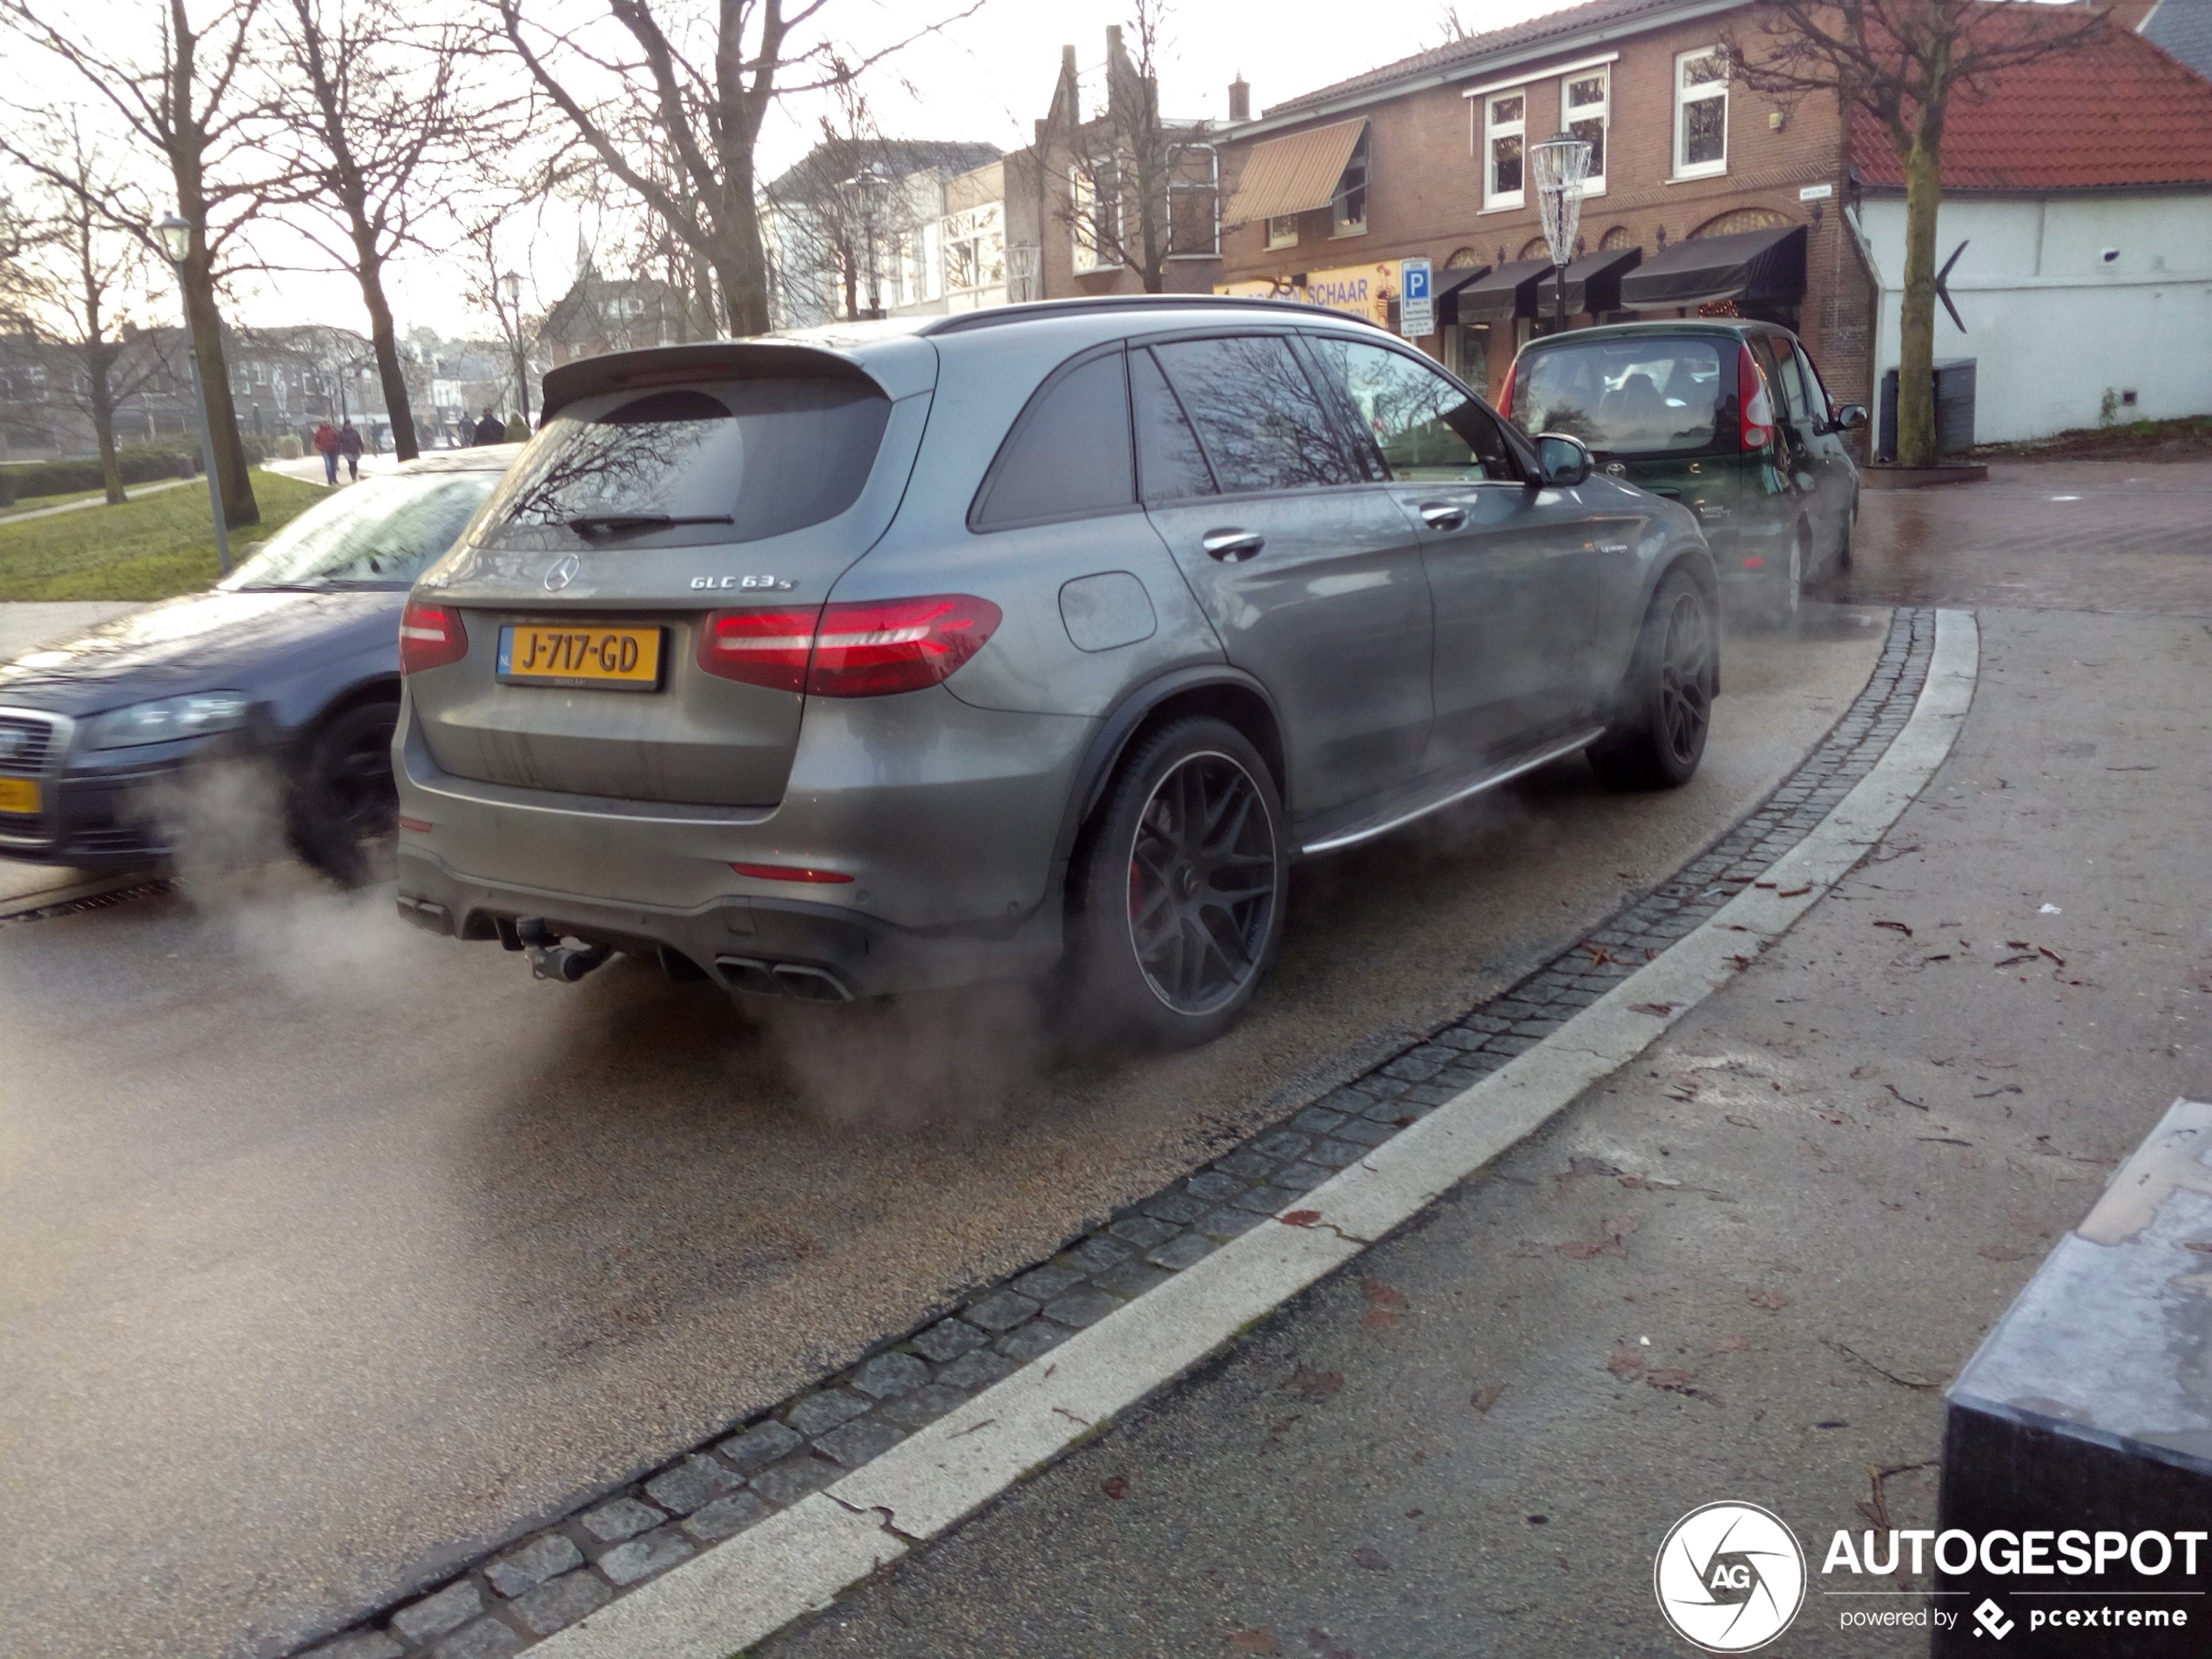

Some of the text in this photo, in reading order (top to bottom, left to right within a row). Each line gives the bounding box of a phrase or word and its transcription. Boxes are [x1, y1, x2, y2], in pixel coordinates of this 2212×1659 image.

[1307, 279, 1368, 306] SCHAAR
[1411, 273, 1424, 296] P
[691, 577, 737, 590] GLC
[500, 655, 510, 667] NL
[523, 633, 638, 672] J-717-GD
